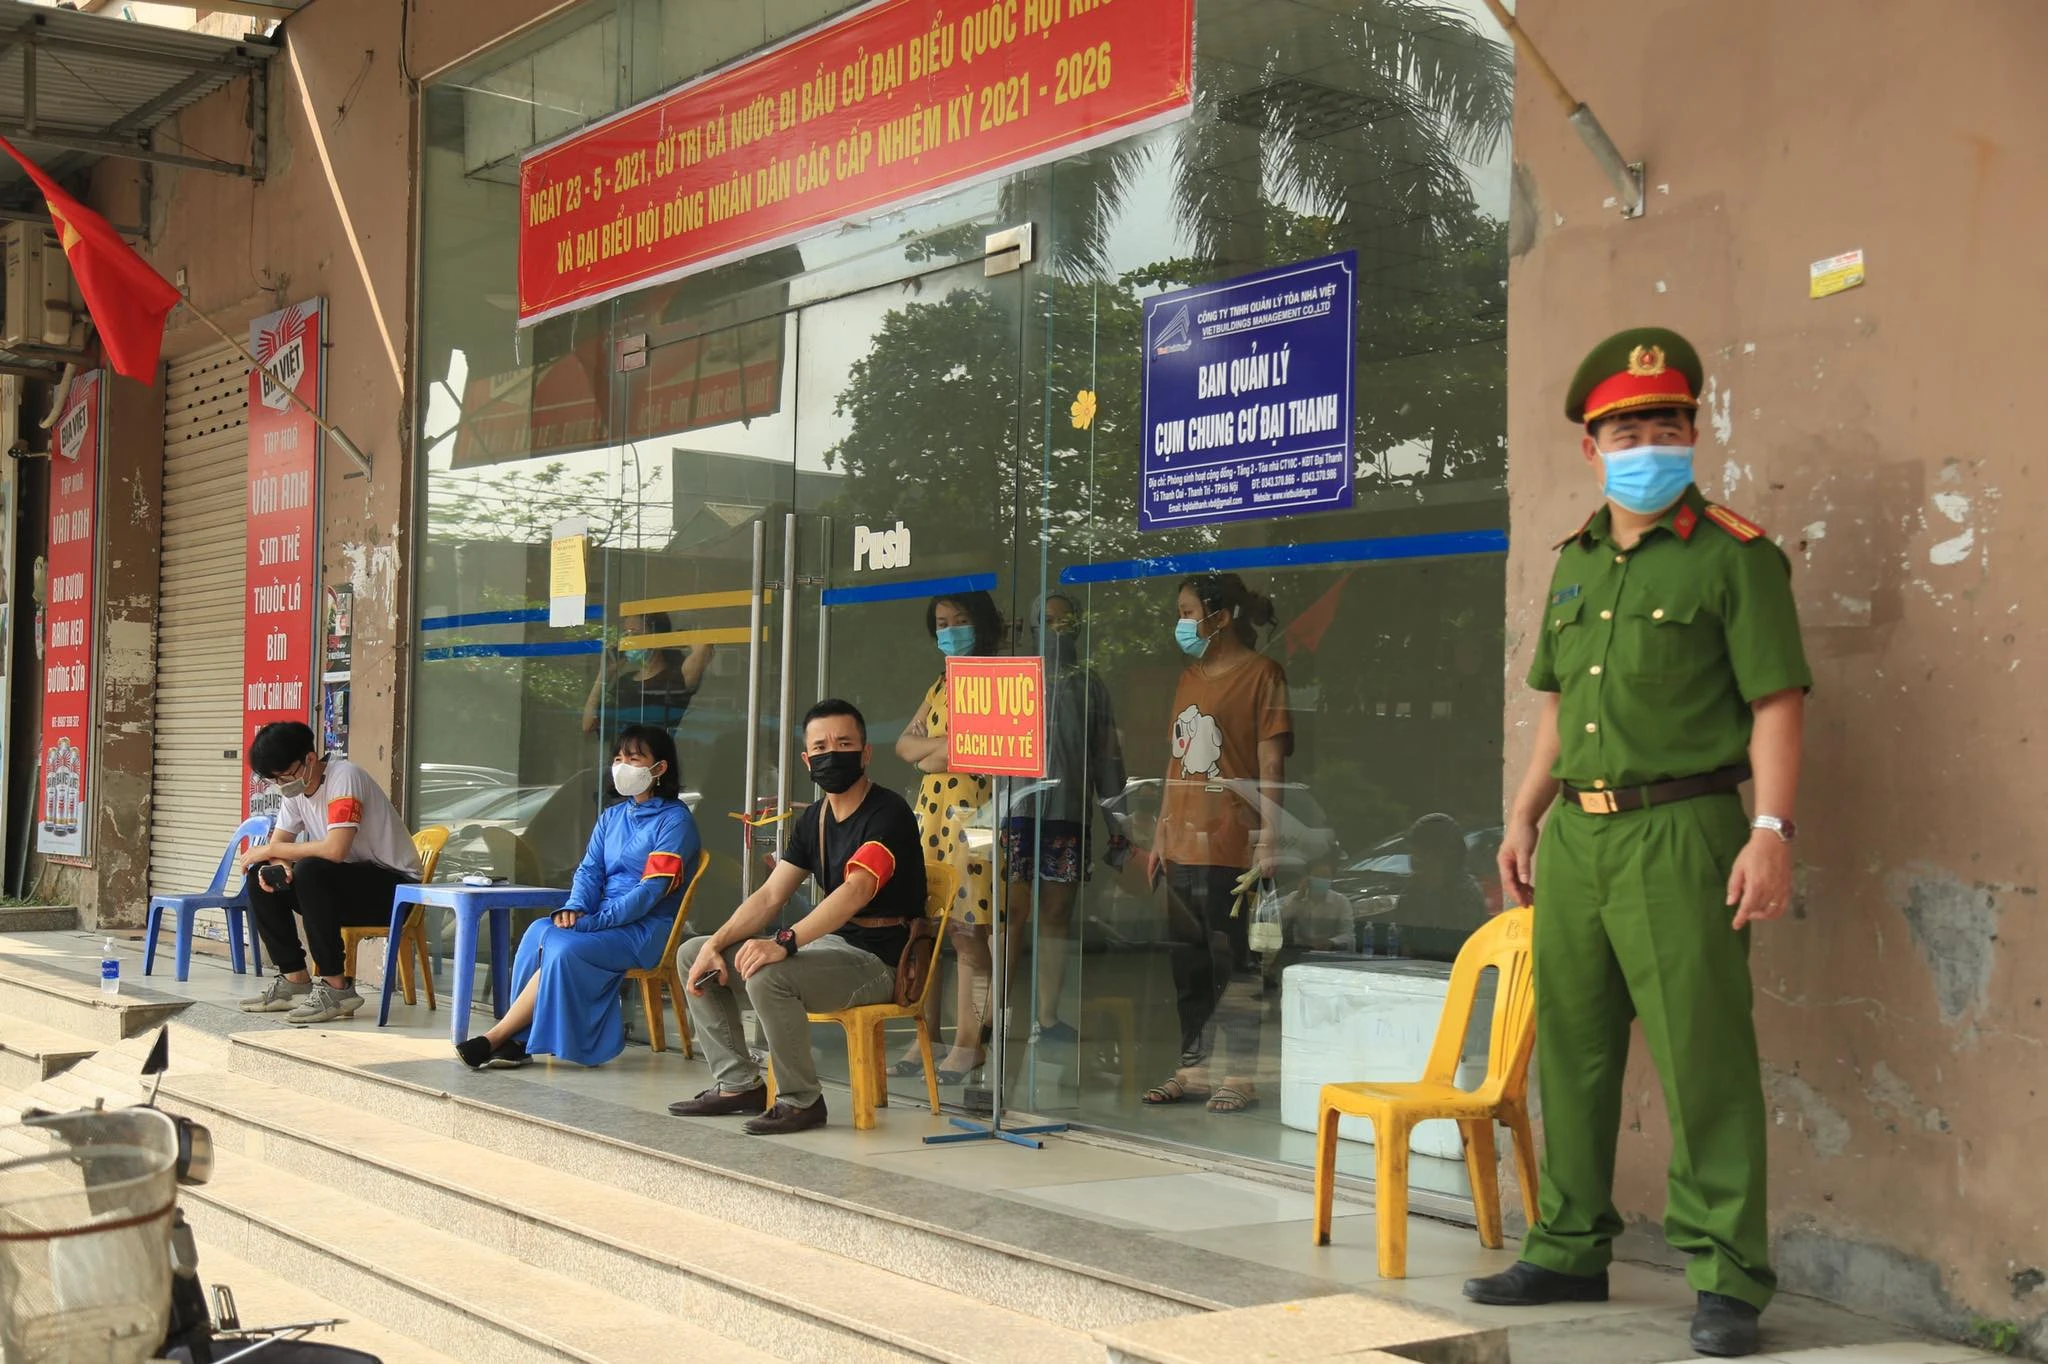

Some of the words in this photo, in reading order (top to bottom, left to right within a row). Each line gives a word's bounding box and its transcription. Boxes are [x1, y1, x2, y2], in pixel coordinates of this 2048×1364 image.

[530, 180, 563, 227] NGÀY
[566, 175, 582, 211] 23
[594, 166, 602, 201] 5
[614, 150, 650, 193] 2021,
[656, 125, 677, 178] CỬ
[679, 126, 700, 169] TRI
[706, 104, 726, 159] CẢ
[731, 93, 775, 150] NƯỚC
[779, 88, 796, 132] ĐI
[801, 62, 836, 124] BẦU
[842, 46, 869, 107] CỬ
[872, 44, 904, 100] ĐẠI
[909, 10, 954, 81] BIỂU
[557, 232, 573, 275] VÀ
[576, 231, 597, 272] ĐẠI
[602, 204, 631, 260] BIỂU
[636, 201, 659, 253] HỘI
[663, 186, 704, 240] ĐỒNG
[708, 170, 752, 224] NHÂN
[756, 157, 791, 208] DÂN
[796, 142, 830, 194] CÁC
[836, 119, 872, 181] CẤP
[878, 103, 941, 167] NHIỆM
[948, 84, 974, 143] KỲ
[979, 72, 1029, 132] 2021
[1039, 85, 1047, 96] -
[1055, 41, 1111, 106] 2026
[1197, 309, 1217, 324] CÔNG
[1219, 308, 1228, 321] TY
[1230, 304, 1249, 319] TNHH
[1250, 295, 1272, 313] QUẢN
[1273, 293, 1282, 308] LÝ
[1283, 292, 1300, 307] TÒA
[1301, 287, 1318, 302] NHÀ
[1319, 282, 1337, 300] VIỆT
[1203, 319, 1251, 336] VIETBUILDINGS
[1252, 307, 1301, 326] MANAGEMENT
[279, 344, 301, 384] VIỆT
[1198, 362, 1227, 399] BAN
[1230, 341, 1269, 397] QUẢN
[1272, 342, 1290, 386] LÝ
[264, 432, 279, 457] TẠP
[1155, 420, 1185, 462] CỤM
[1188, 411, 1234, 451] CHUNG
[1238, 403, 1259, 444] CƯ
[1260, 402, 1285, 446] ĐẠI
[1288, 393, 1338, 436] THANH
[252, 471, 277, 516] VÂN
[281, 470, 309, 510] ANH
[53, 508, 70, 545] VÂN
[72, 508, 90, 540] ANH
[259, 536, 279, 566] SIM
[281, 525, 300, 563] THẺ
[854, 521, 911, 571] Push
[53, 576, 64, 603] BIA
[65, 572, 84, 606] RƯỢU
[254, 577, 286, 615] THUỐC
[288, 576, 301, 611] LÁ
[52, 616, 69, 648] BÁNH
[70, 618, 84, 651] KẸO
[267, 626, 287, 661] BỈM
[47, 661, 70, 693] ĐƯỜNG
[71, 660, 85, 692] SỮA
[248, 677, 267, 711] NƯỚC
[268, 675, 282, 710] GIẢI
[284, 675, 303, 710] KHÁT
[955, 676, 992, 715] KHU
[996, 673, 1035, 725] VỰC
[956, 729, 988, 756] CÁCH
[991, 735, 1003, 757] LY
[1007, 735, 1015, 757] Y
[1018, 729, 1034, 758] TẾ
